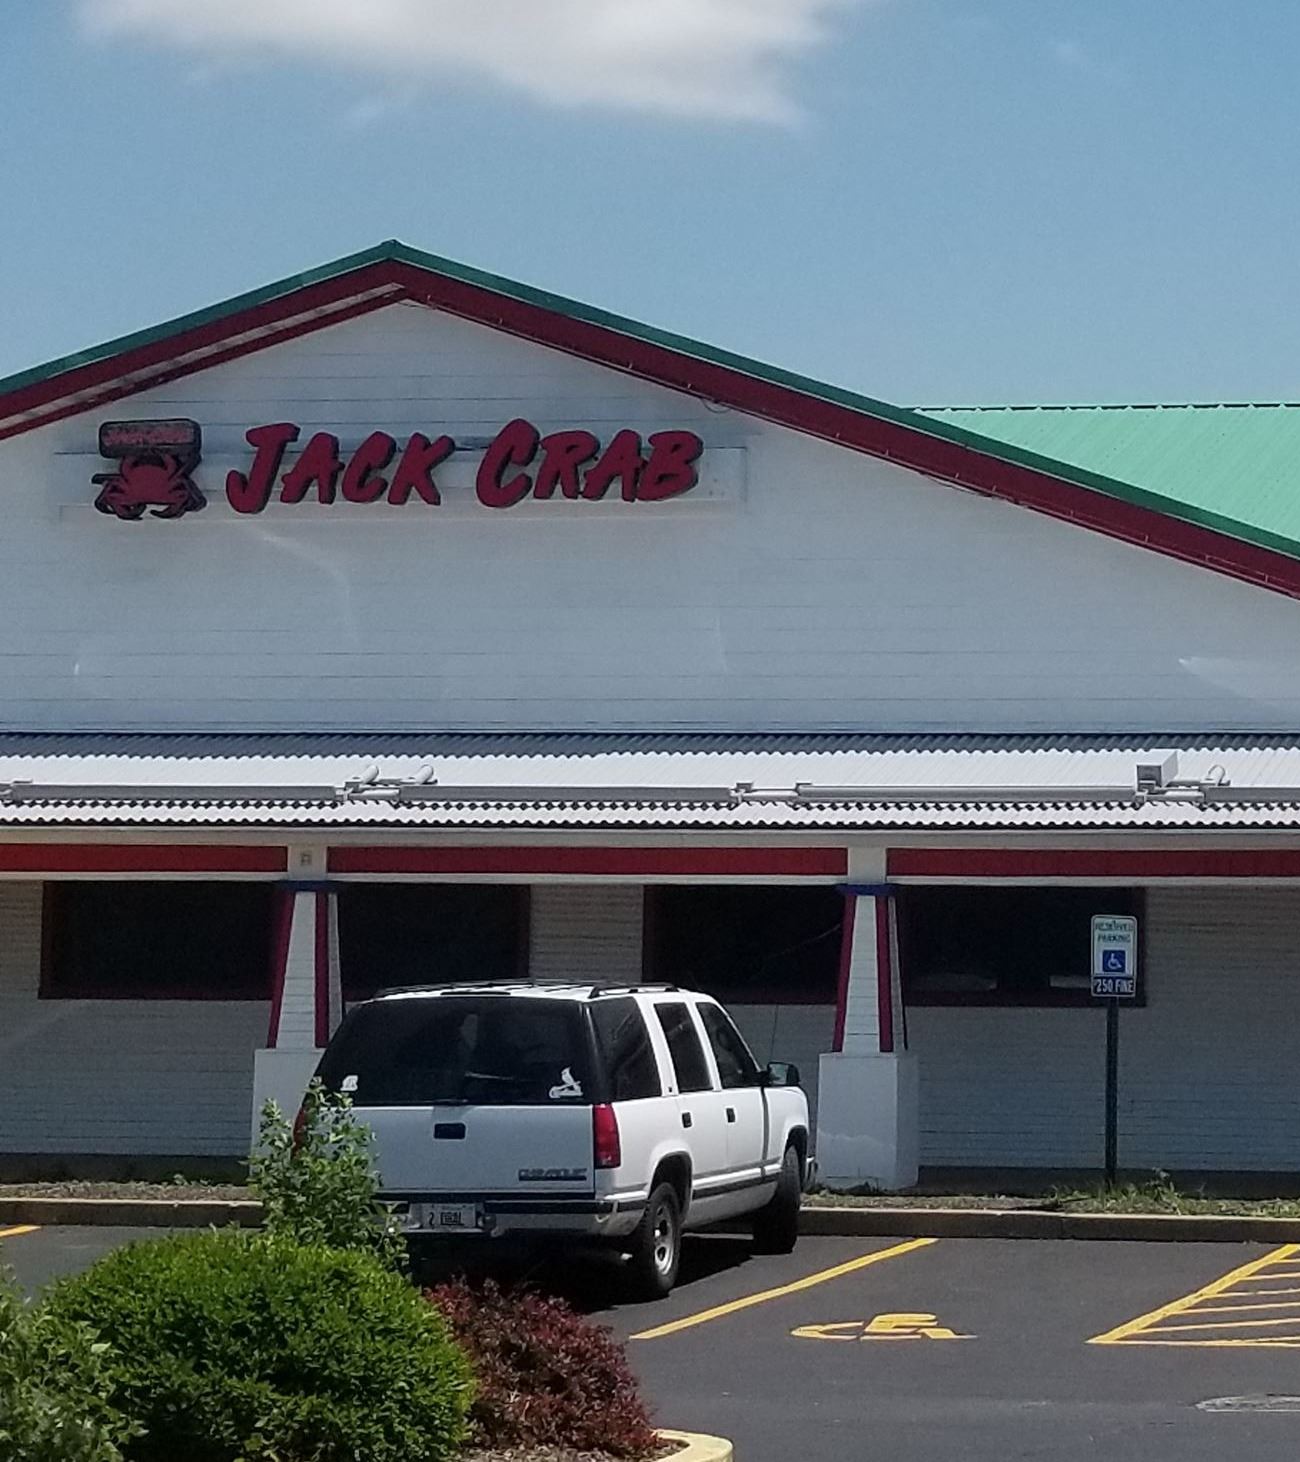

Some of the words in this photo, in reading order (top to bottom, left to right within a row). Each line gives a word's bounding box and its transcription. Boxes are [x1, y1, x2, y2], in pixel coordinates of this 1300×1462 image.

[226, 422, 457, 514] JACK
[476, 418, 704, 509] CRAB
[1098, 934, 1131, 942] PARKING
[1115, 979, 1134, 993] FINE
